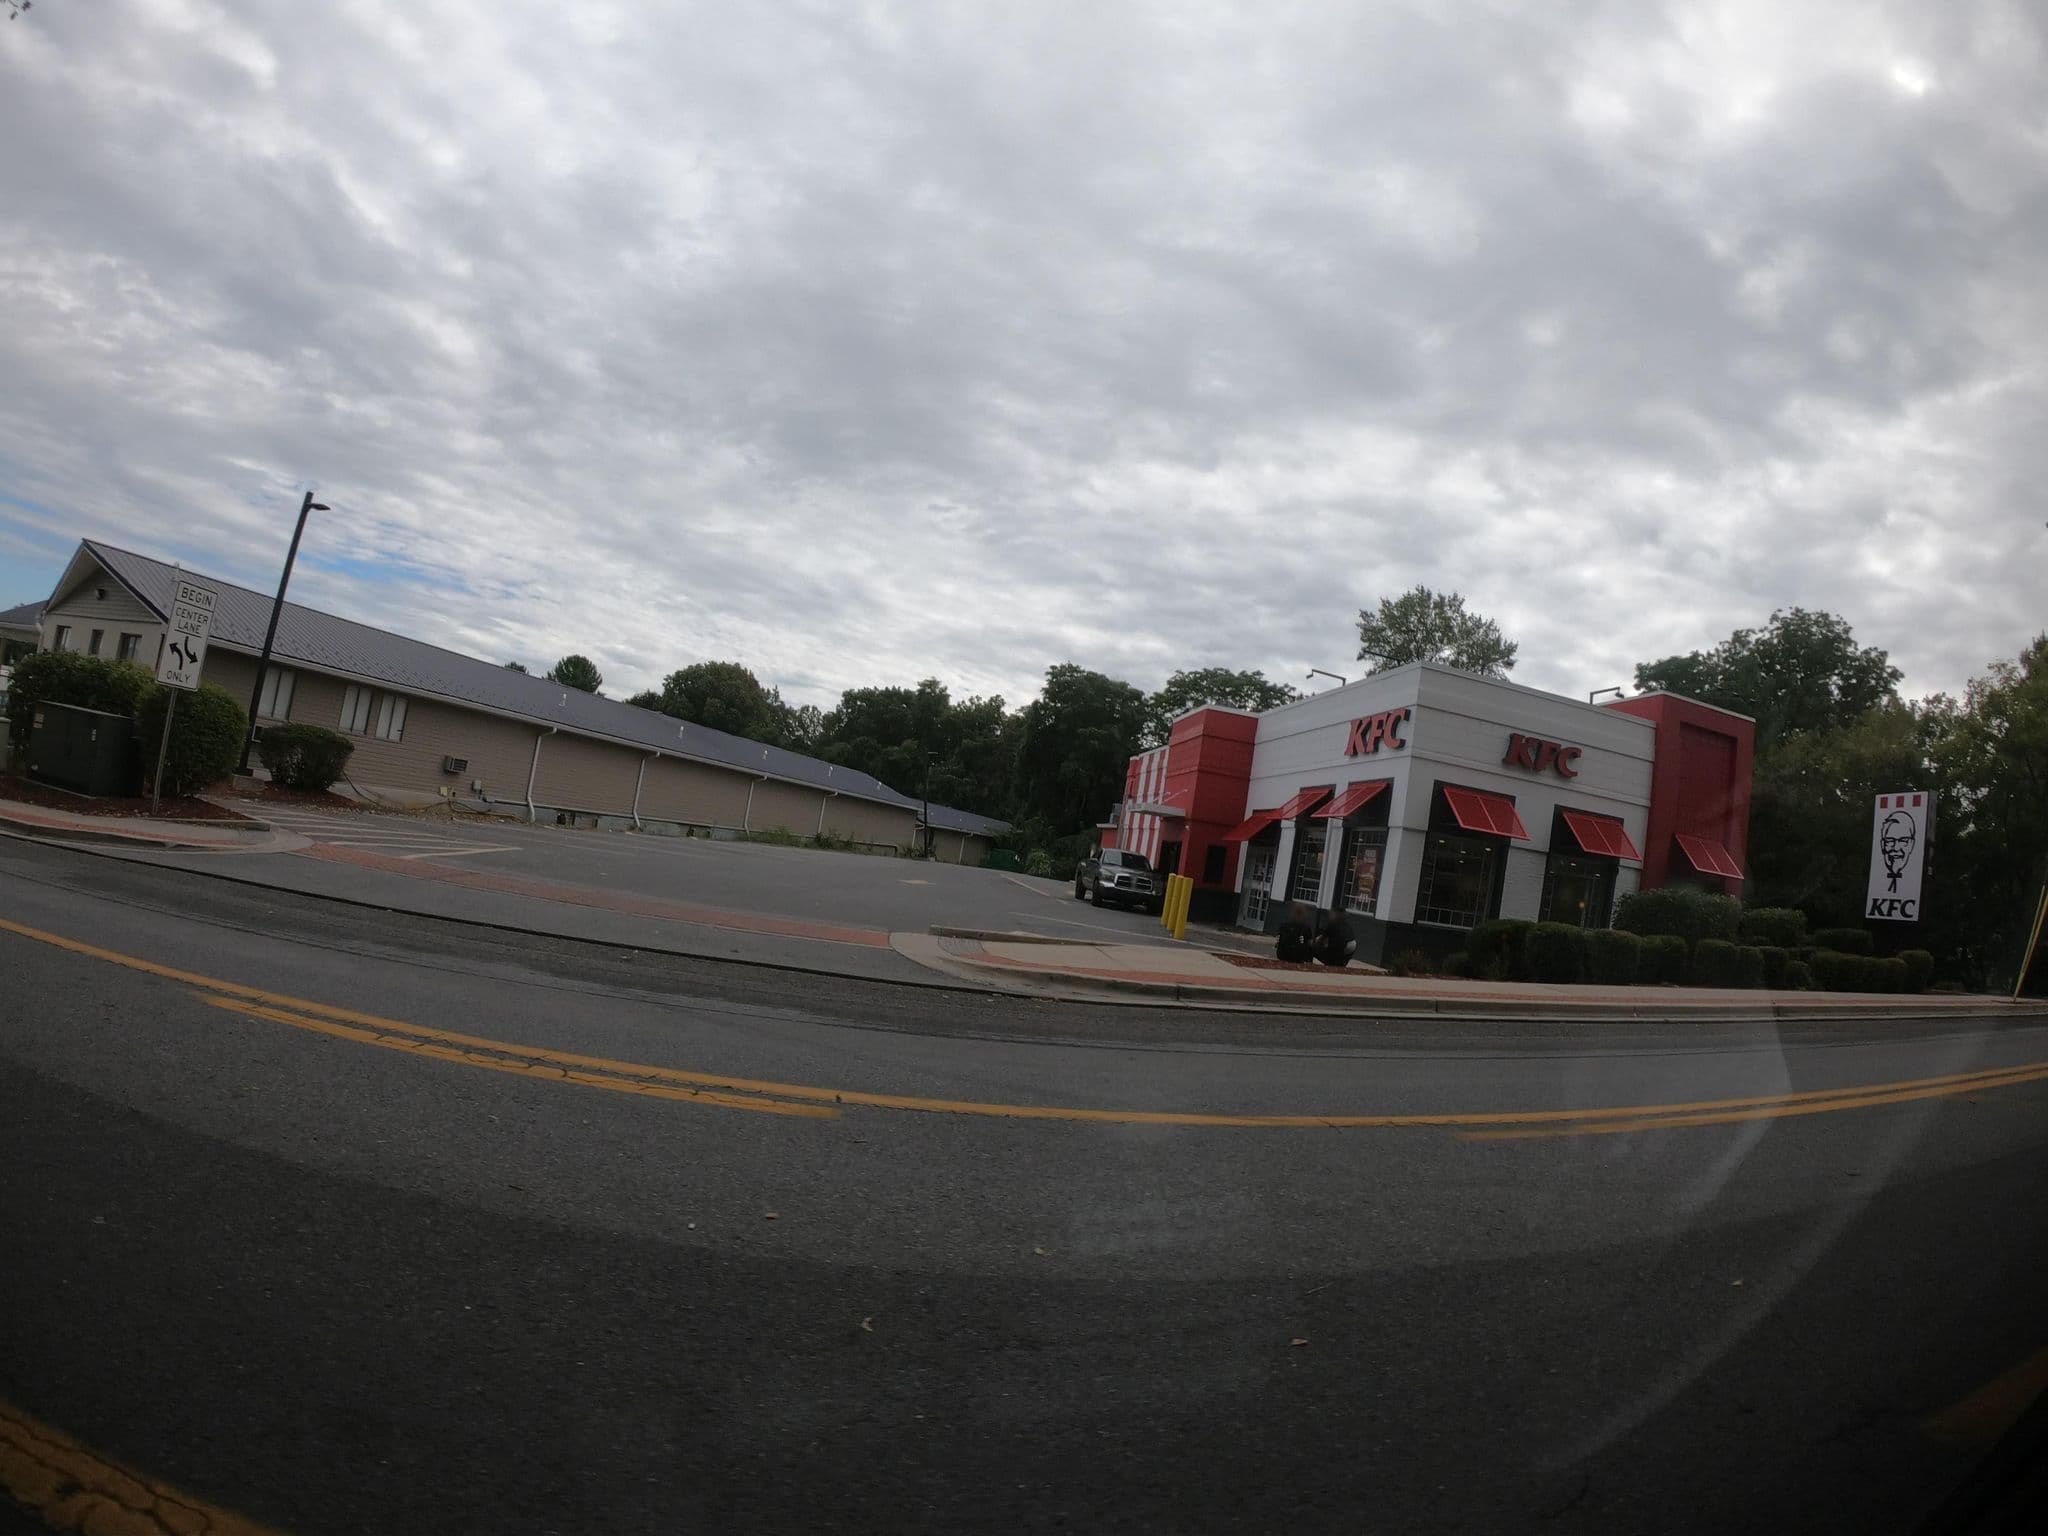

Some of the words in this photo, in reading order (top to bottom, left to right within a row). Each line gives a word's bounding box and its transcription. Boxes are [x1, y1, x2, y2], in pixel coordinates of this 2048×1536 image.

[181, 587, 212, 607] BEGIN
[176, 607, 208, 624] CENTER
[178, 619, 201, 634] LANE
[167, 670, 190, 682] ONLY
[1344, 707, 1411, 757] KFC
[1502, 733, 1582, 779] KFC
[1868, 898, 1916, 918] KFC
